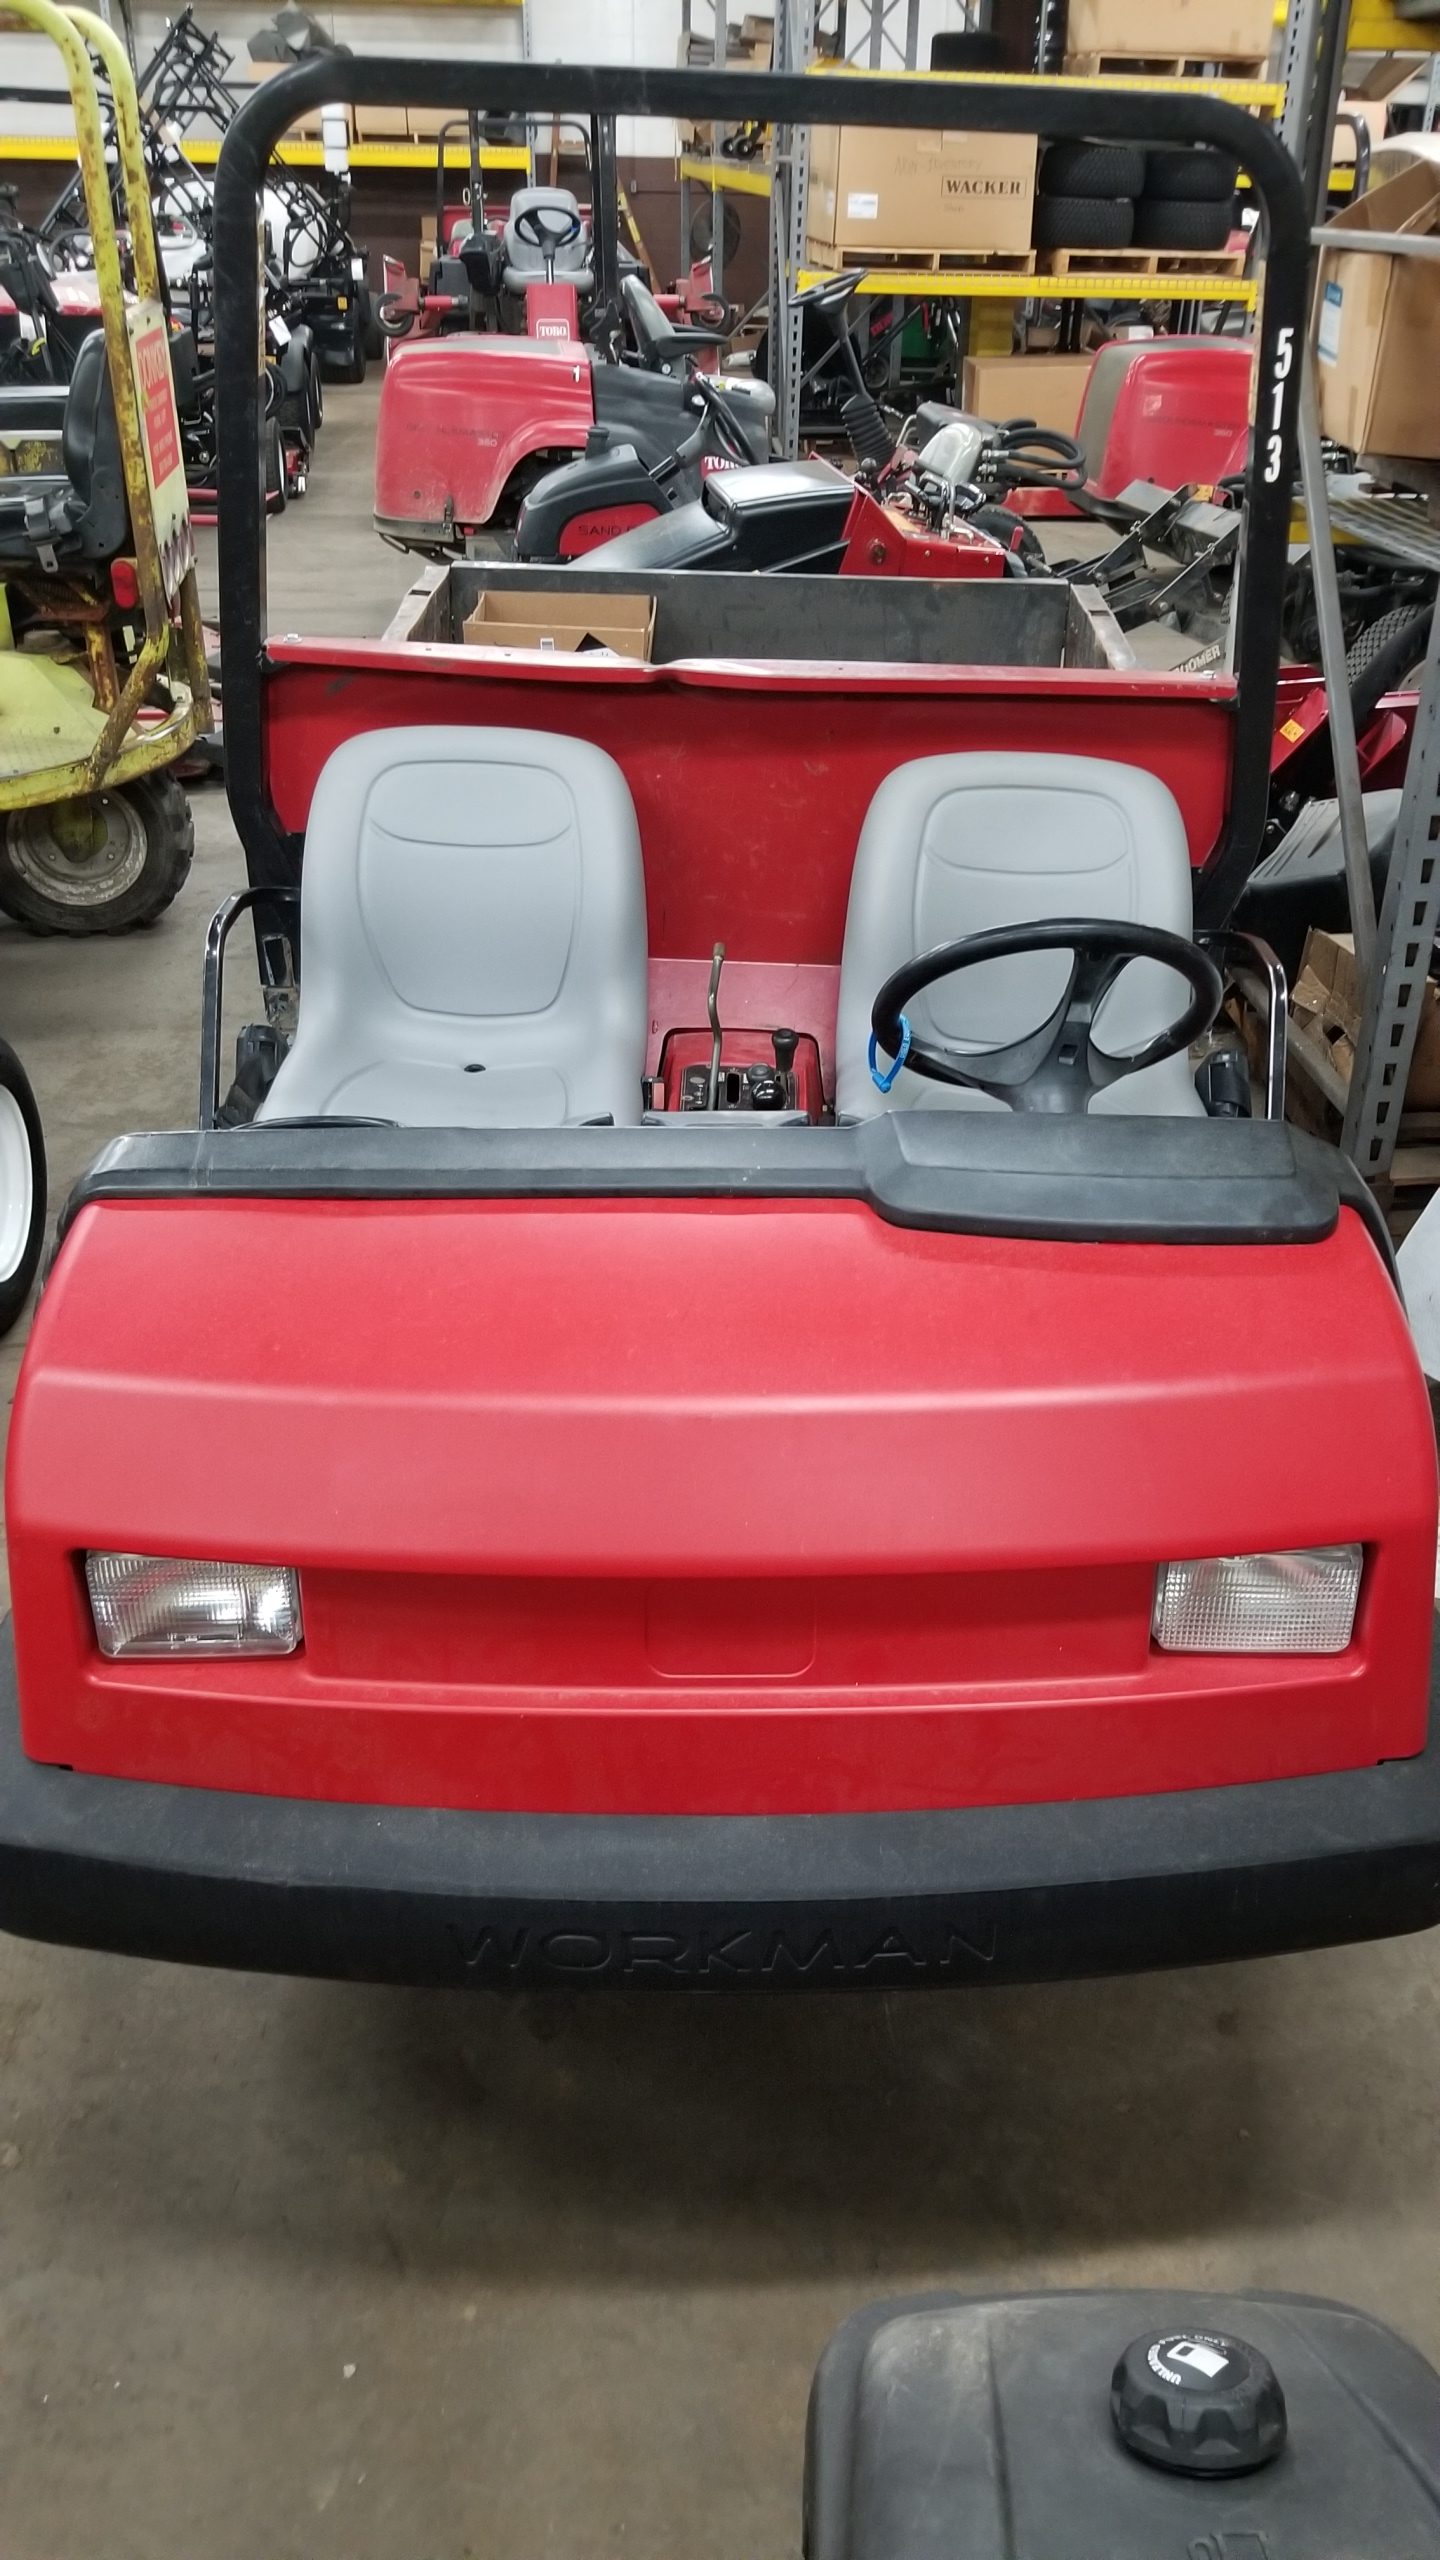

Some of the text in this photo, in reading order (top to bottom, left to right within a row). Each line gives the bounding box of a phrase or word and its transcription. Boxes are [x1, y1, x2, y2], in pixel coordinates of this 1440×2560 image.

[946, 179, 1021, 196] WACKER
[540, 325, 567, 337] TORO
[1264, 327, 1295, 484] 513
[448, 1919, 999, 1974] WORKMAN
